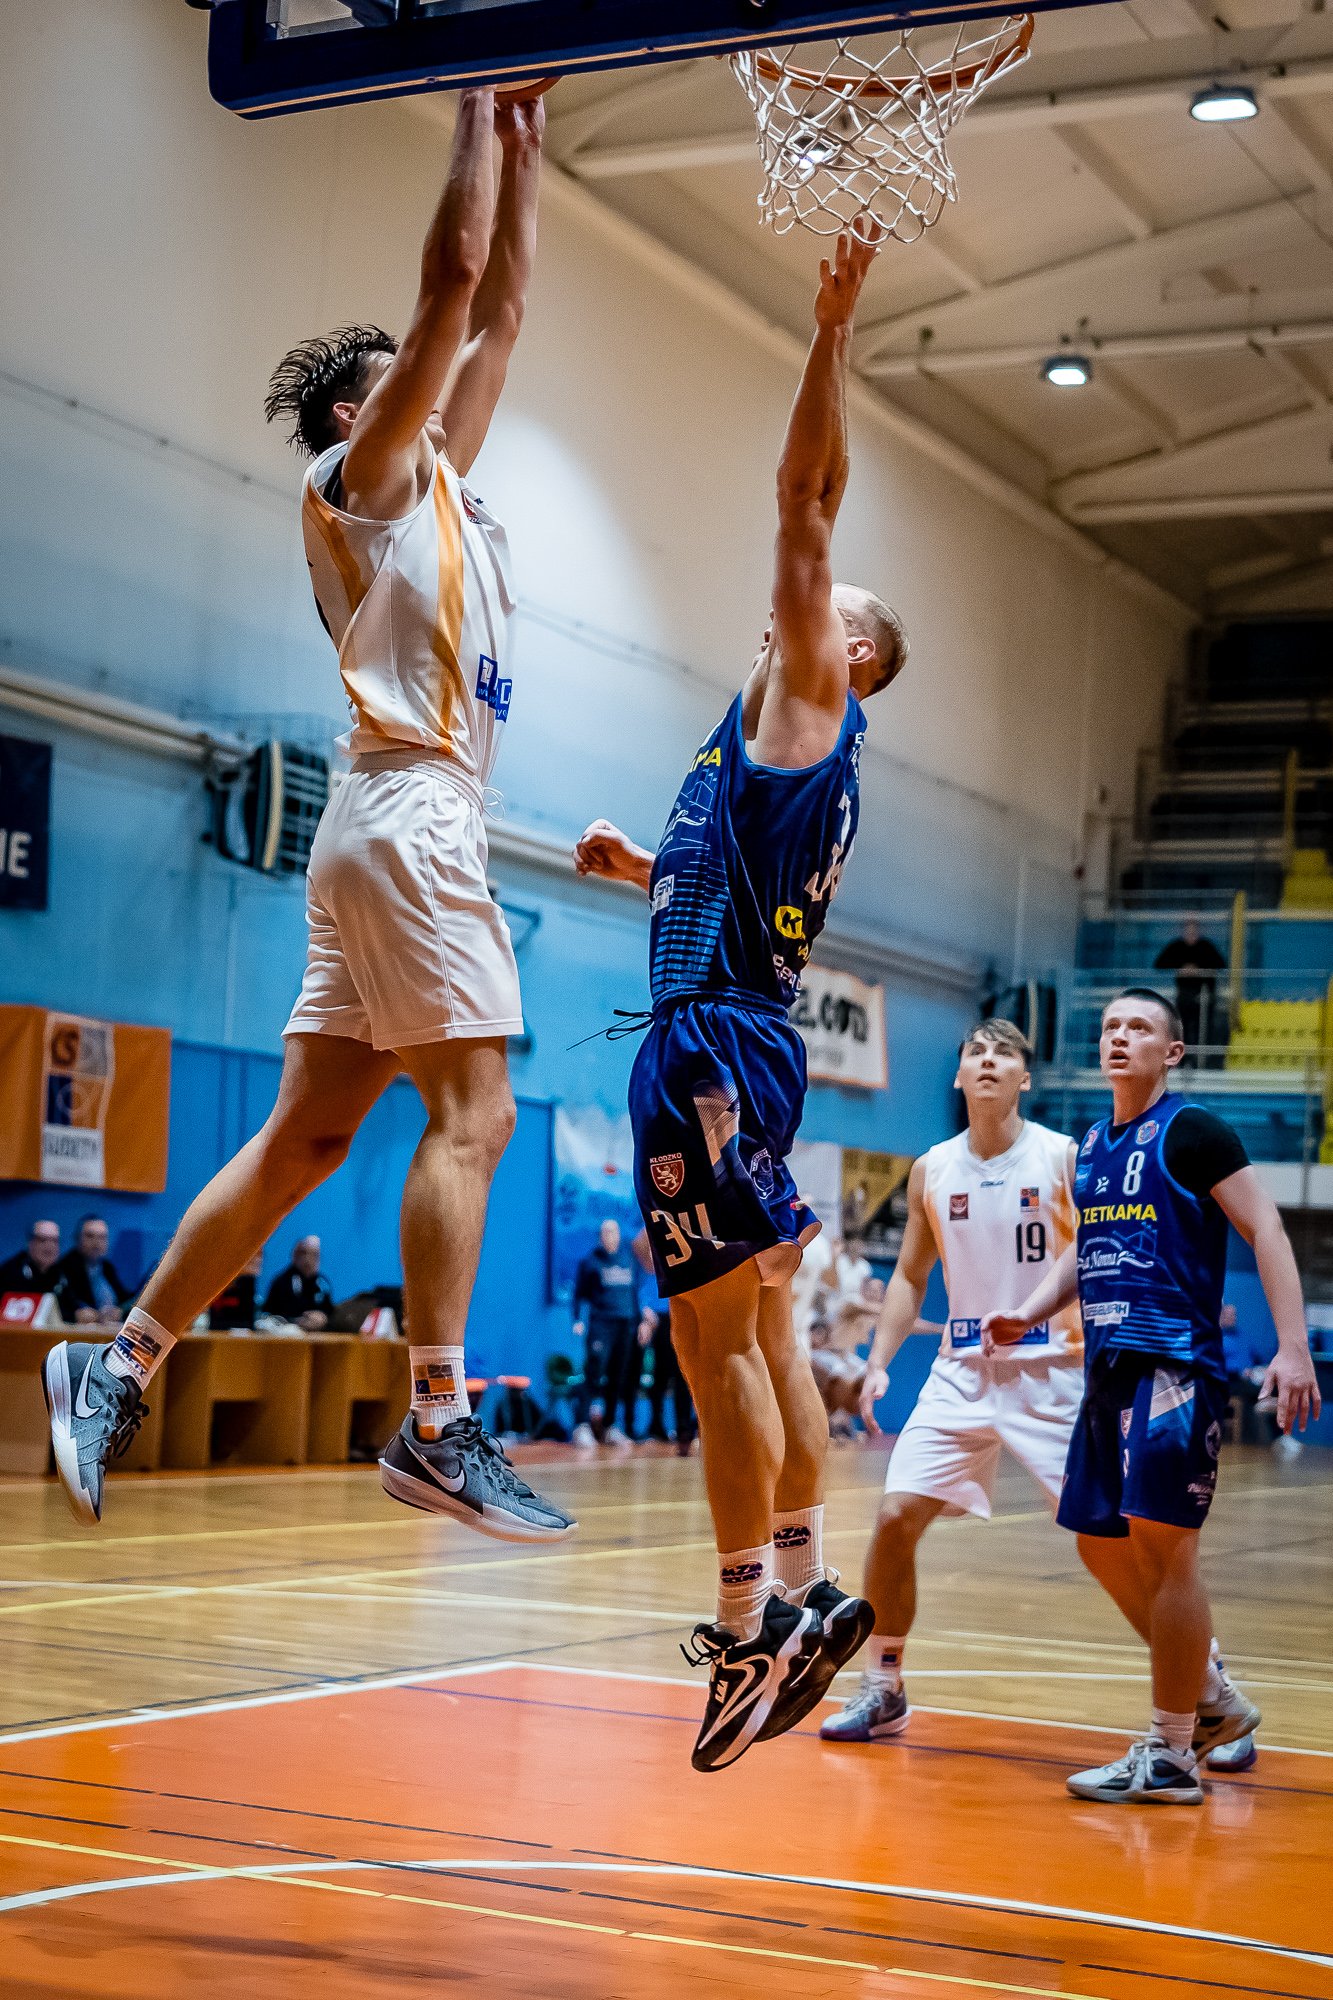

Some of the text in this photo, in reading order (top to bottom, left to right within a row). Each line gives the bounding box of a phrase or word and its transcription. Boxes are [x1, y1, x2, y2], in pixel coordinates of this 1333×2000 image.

[1122, 1150, 1146, 1196] 8
[650, 1202, 726, 1268] 34
[1083, 1204, 1158, 1224] ZETKAMA
[1015, 1221, 1047, 1263] 19
